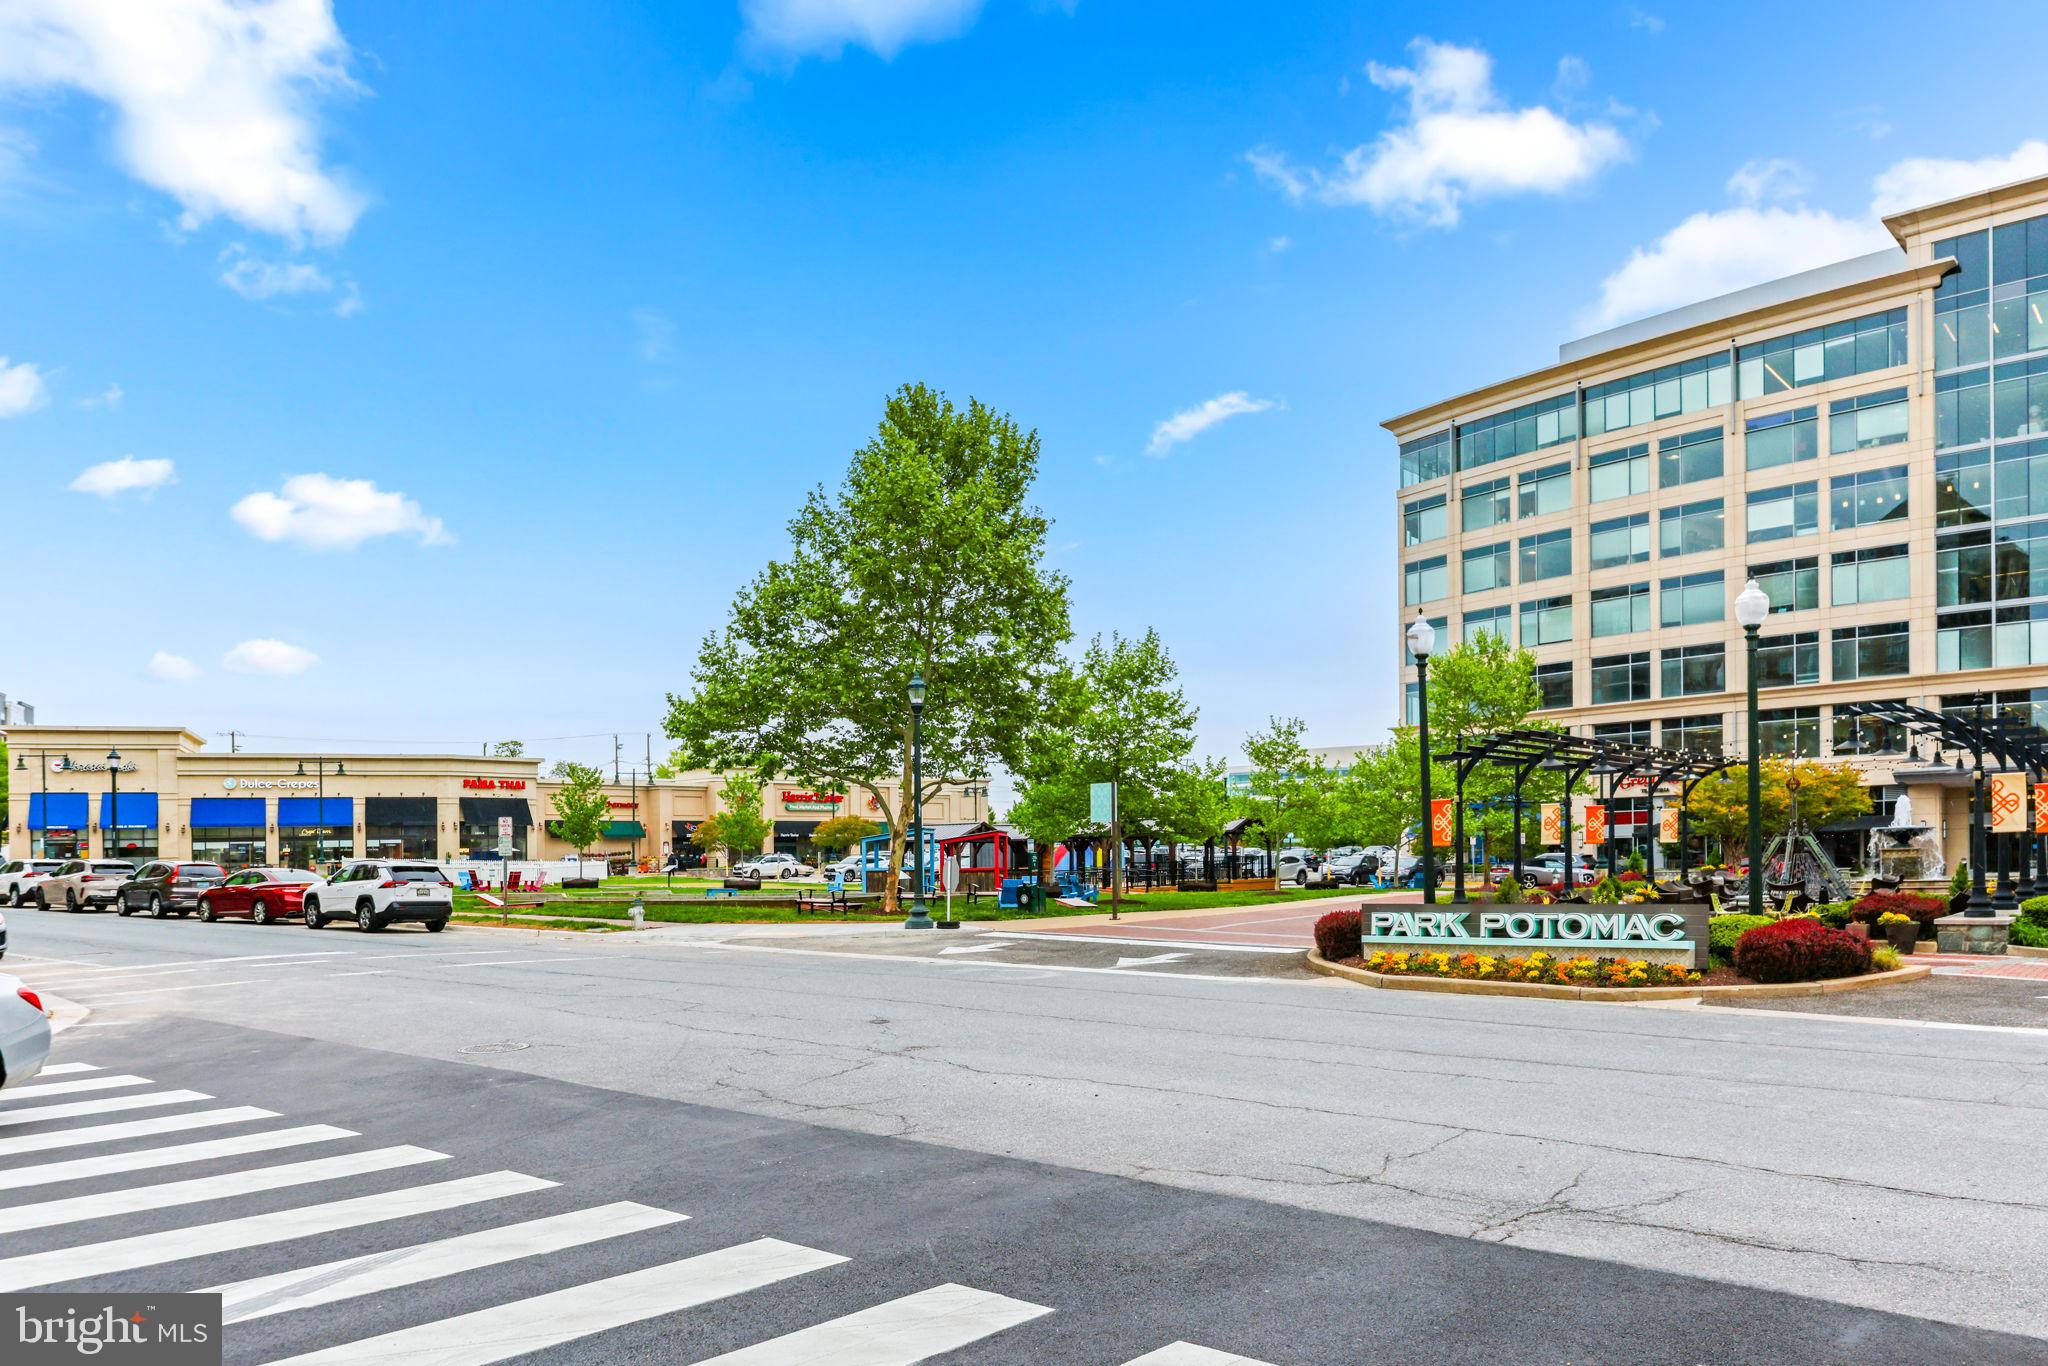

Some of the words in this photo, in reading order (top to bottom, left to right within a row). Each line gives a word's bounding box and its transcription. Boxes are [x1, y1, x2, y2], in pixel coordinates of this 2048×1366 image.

[240, 779, 273, 789] Dulce
[277, 779, 319, 790] Crepes
[498, 780, 526, 790] THAI
[782, 791, 813, 803] Harris
[813, 792, 844, 804] Teter
[1371, 912, 1471, 938] PARK
[1480, 912, 1686, 942] POTOMAC
